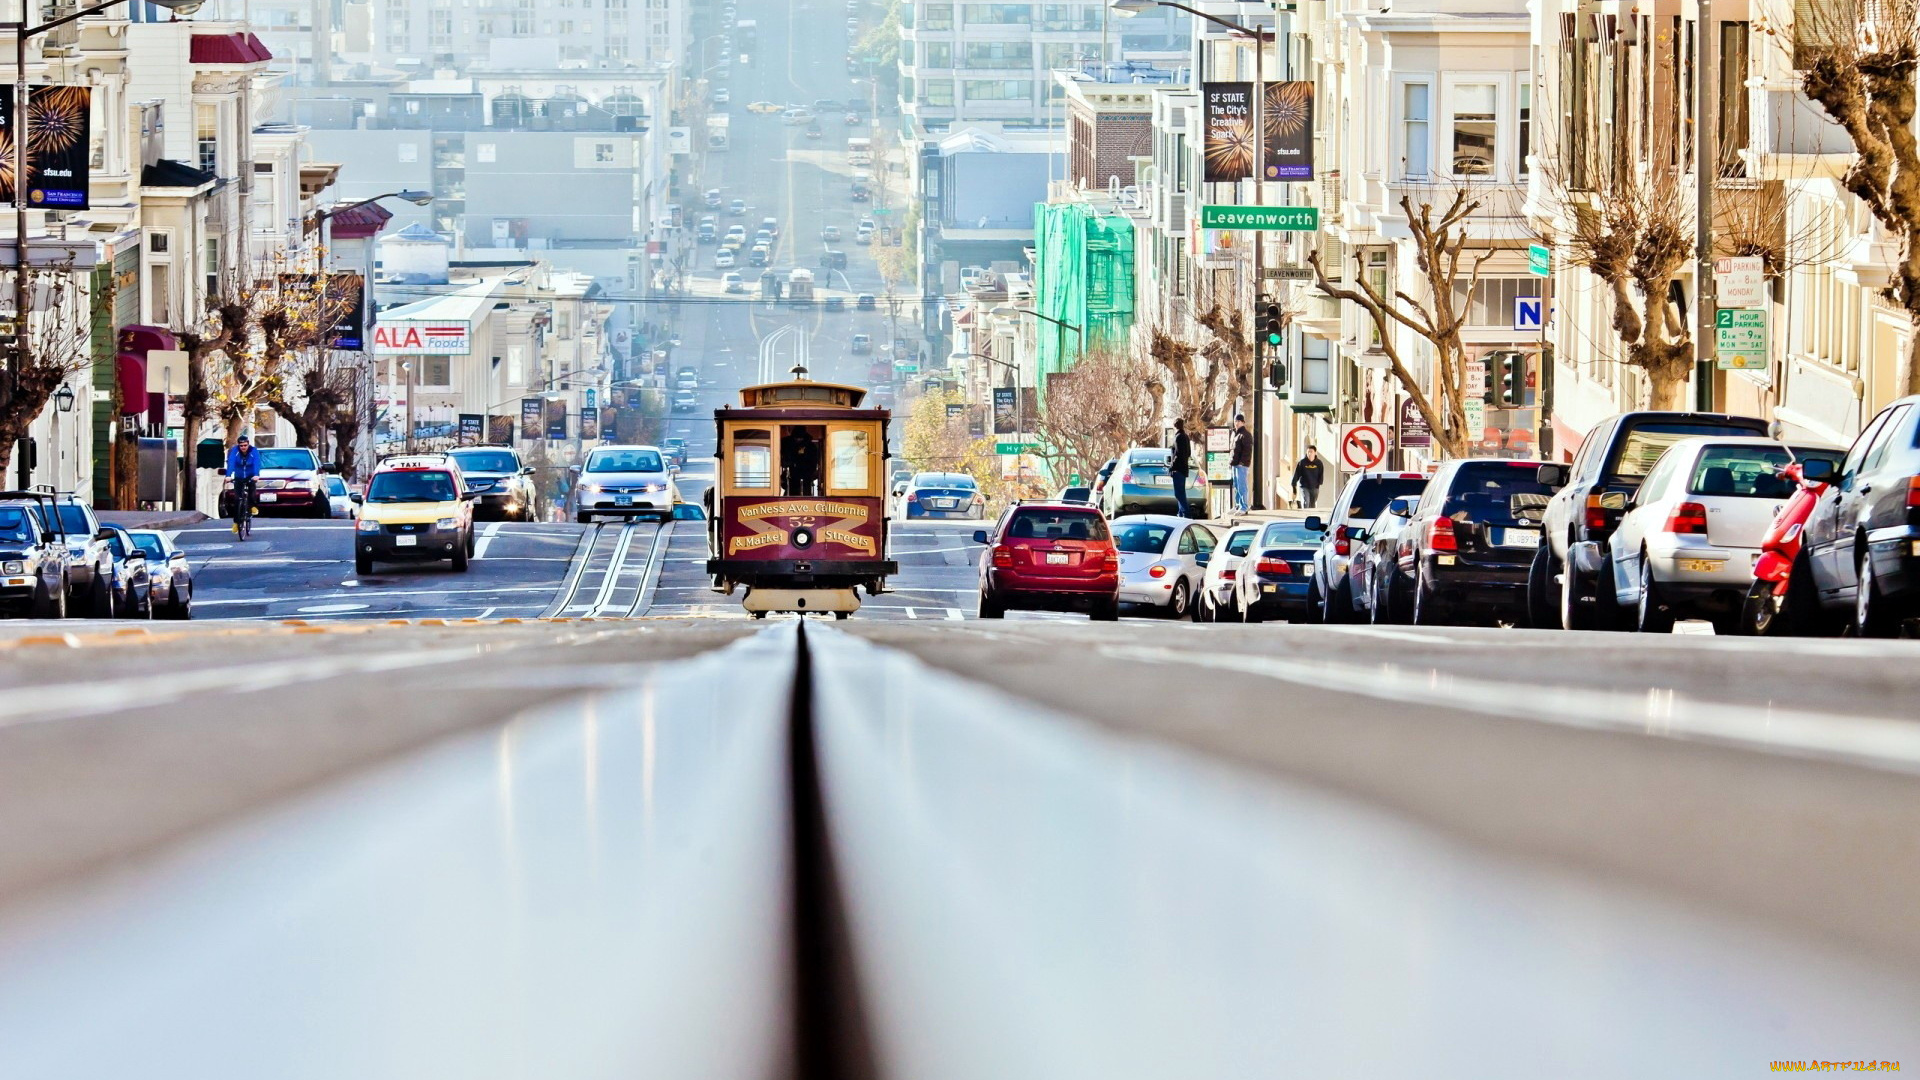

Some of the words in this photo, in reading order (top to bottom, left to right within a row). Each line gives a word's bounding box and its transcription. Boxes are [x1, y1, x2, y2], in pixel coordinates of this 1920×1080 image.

[1210, 93, 1220, 103] SF
[1222, 93, 1245, 103] STATE
[1211, 105, 1225, 115] The
[1226, 105, 1247, 116] City's
[1211, 117, 1244, 127] Creative
[1211, 129, 1234, 140] Spark
[1277, 147, 1300, 155] sfsu.edu
[43, 167, 72, 177] sfsu.edu
[1207, 210, 1313, 225] Leavenworth
[1719, 260, 1731, 273] NO
[1733, 262, 1760, 272] PARKING
[1266, 270, 1312, 278] LEAVENWORTH
[1727, 288, 1754, 296] MONDAY
[1720, 312, 1731, 325] 2
[427, 336, 465, 348] Foods
[1465, 365, 1483, 373] ARKING
[740, 507, 759, 517] Van
[760, 505, 785, 515] Ness
[815, 504, 867, 517] California
[788, 516, 816, 528] 52
[735, 538, 743, 547] &
[745, 533, 783, 547] Market
[825, 531, 869, 546] Streets
